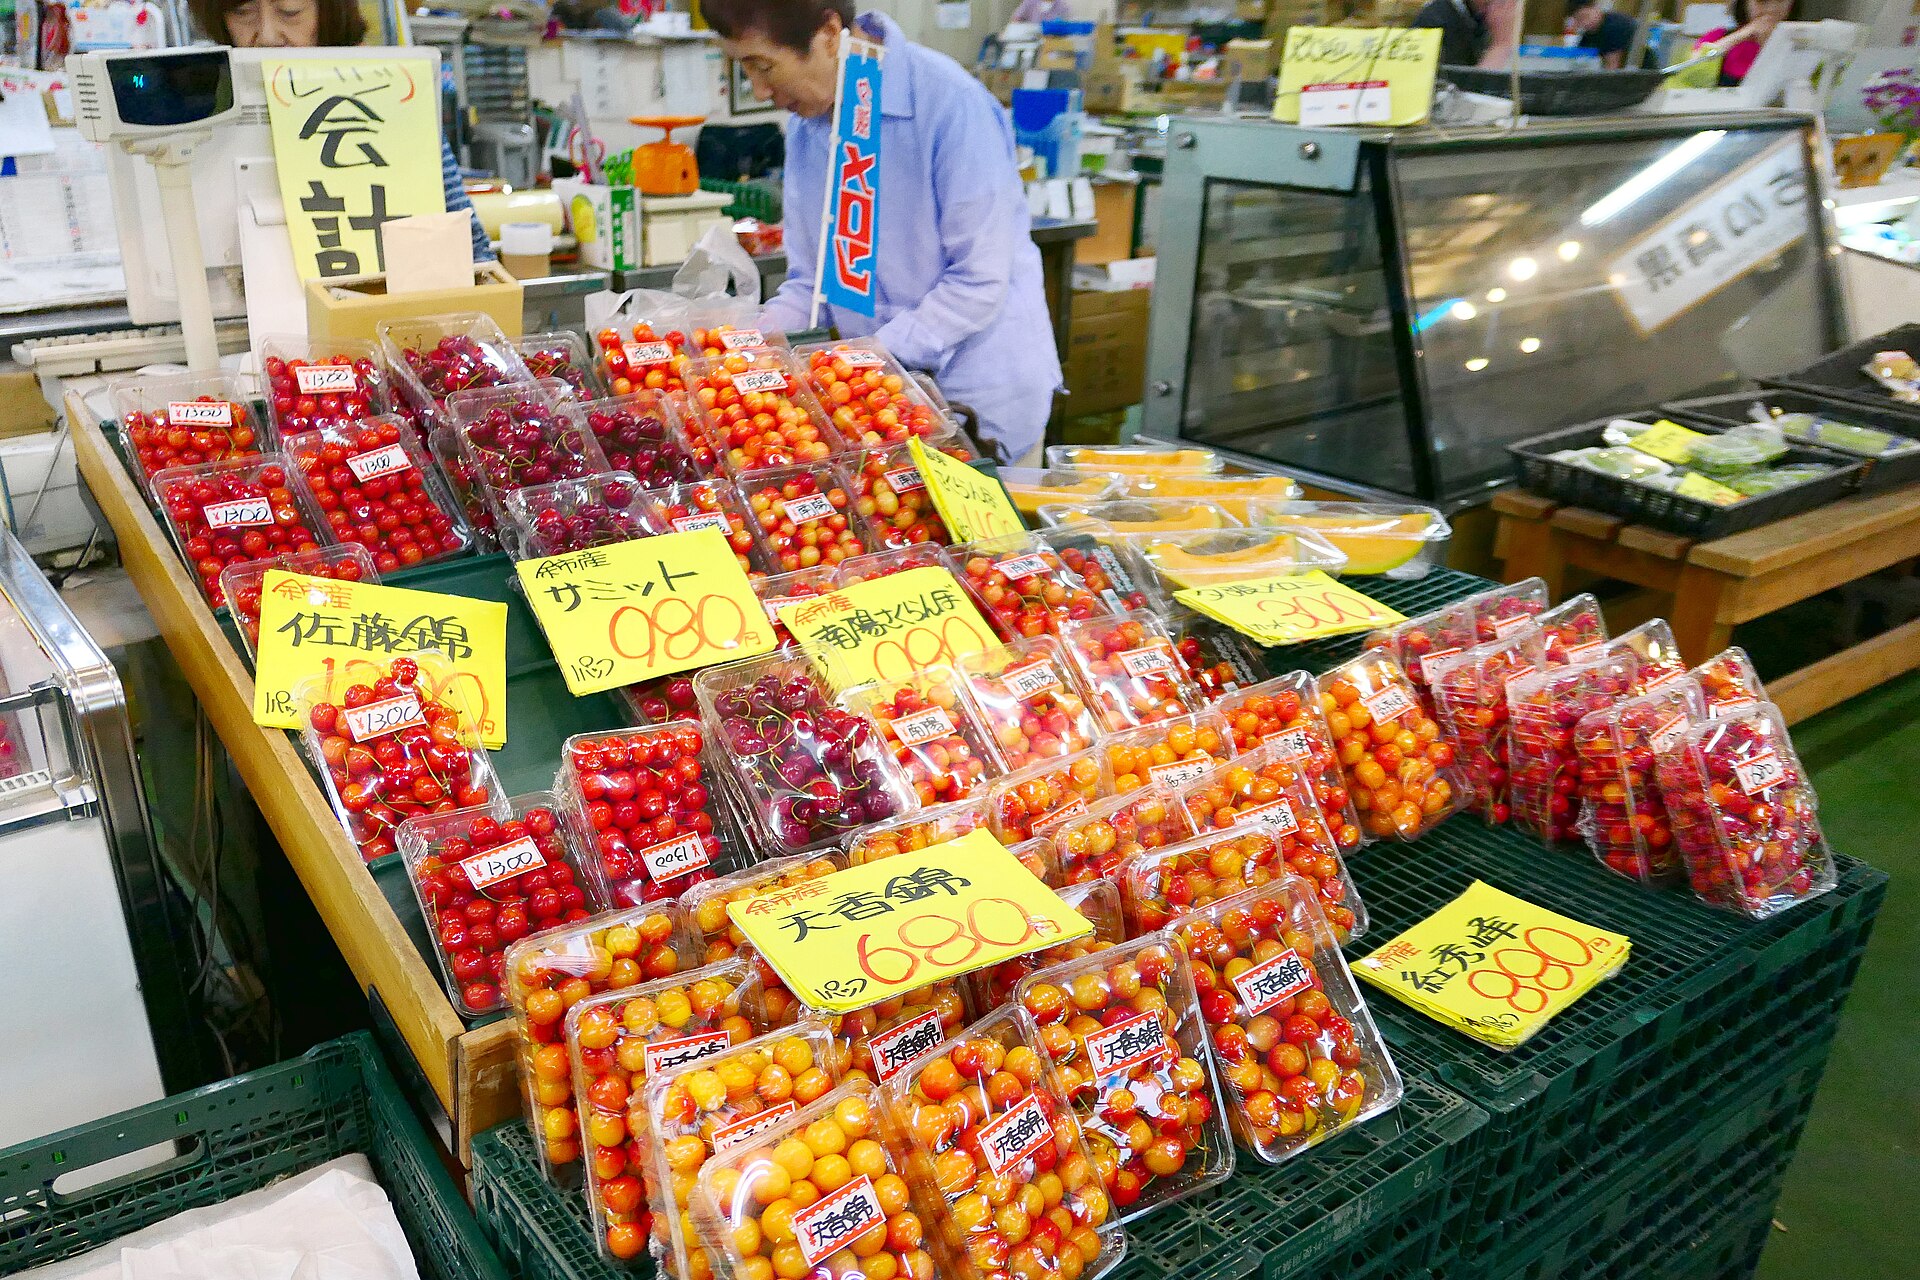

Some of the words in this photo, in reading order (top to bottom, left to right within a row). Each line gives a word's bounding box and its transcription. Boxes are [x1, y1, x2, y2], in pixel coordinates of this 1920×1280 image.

[303, 370, 349, 388] ¥1300
[176, 406, 223, 419] ¥1300
[359, 454, 391, 473] ¥1300
[214, 505, 269, 524] ¥1300
[543, 560, 699, 613] サミット
[810, 583, 964, 650] 南陽さくらんぼ
[277, 611, 473, 664] 佐藤錦
[355, 703, 422, 732] ¥1300
[472, 851, 533, 878] ¥1300
[778, 866, 971, 943] 天香錦
[1401, 915, 1521, 996] 紅秀峰
